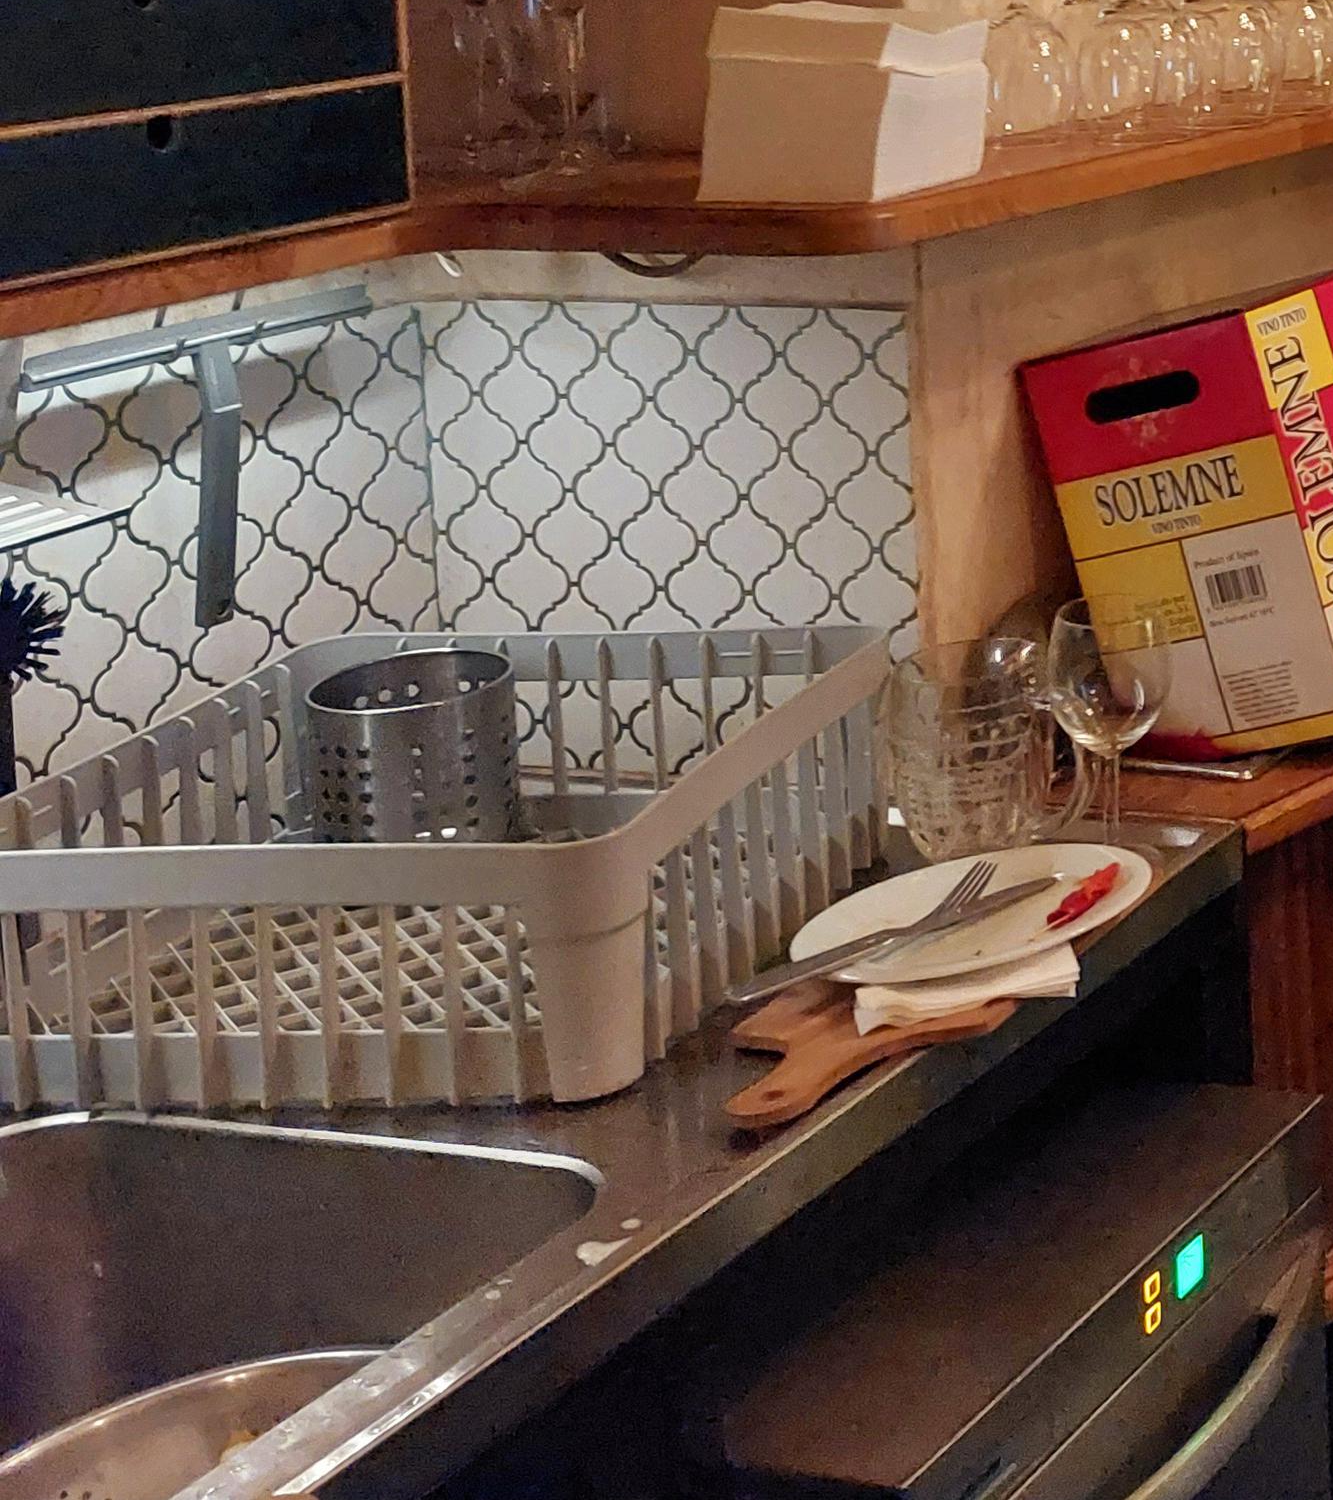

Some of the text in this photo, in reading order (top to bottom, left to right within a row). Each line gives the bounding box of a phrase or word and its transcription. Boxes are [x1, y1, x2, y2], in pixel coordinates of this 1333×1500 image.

[1256, 306, 1308, 338] VINO TINTO
[1095, 454, 1245, 527] SOLEMNE
[1151, 514, 1203, 534] VINO TINTO
